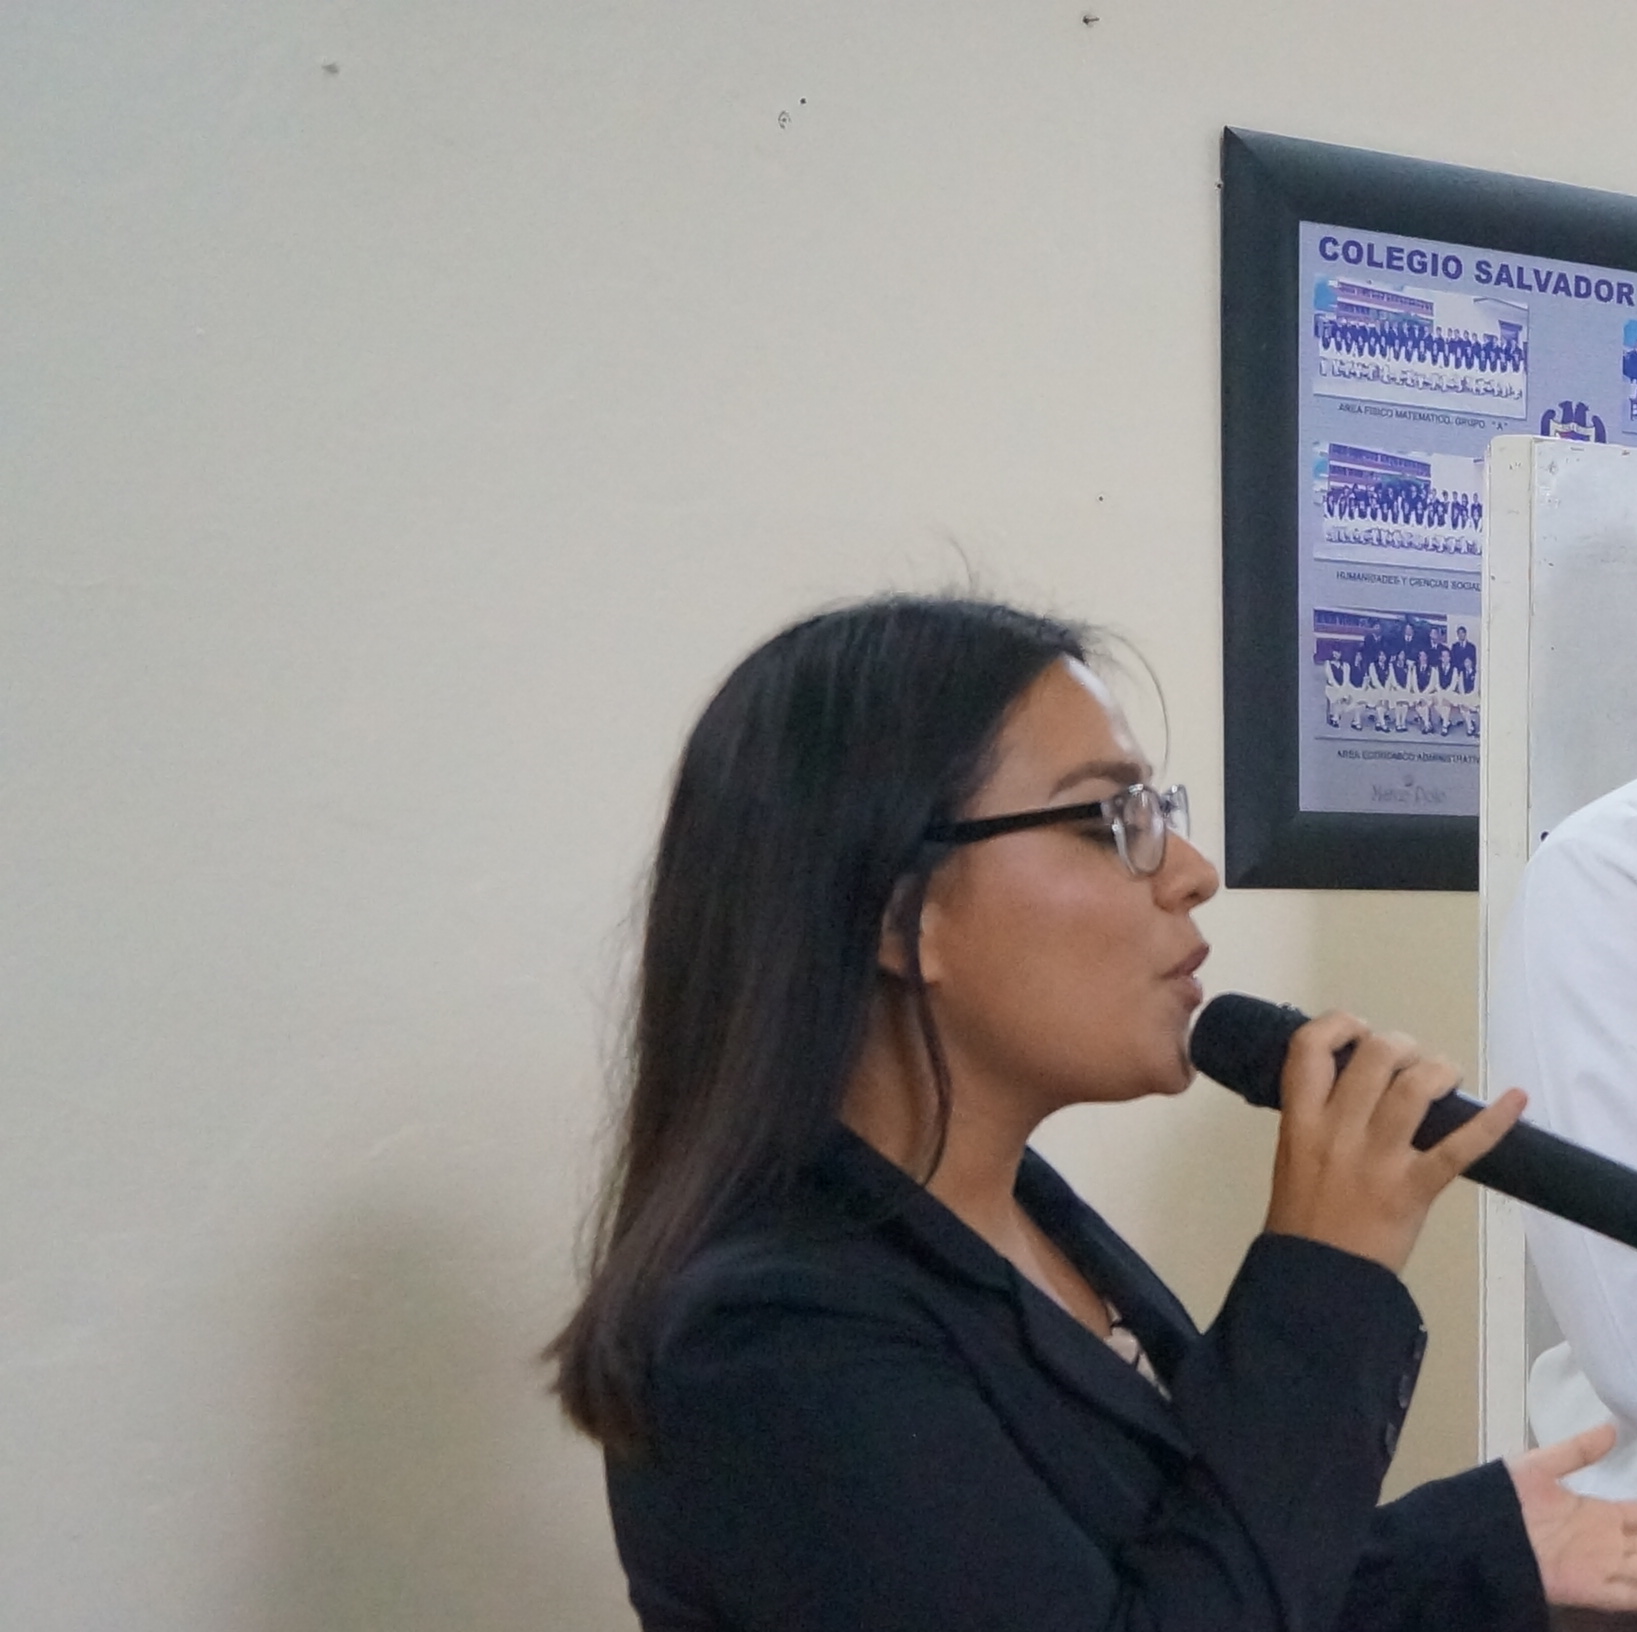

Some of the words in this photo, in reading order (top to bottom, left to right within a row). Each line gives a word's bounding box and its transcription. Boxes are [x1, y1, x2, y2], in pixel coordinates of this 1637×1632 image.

[1318, 235, 1464, 280] COLEGIO
[1473, 260, 1636, 308] SALVADOR
[1451, 581, 1482, 592] SOCIAL
